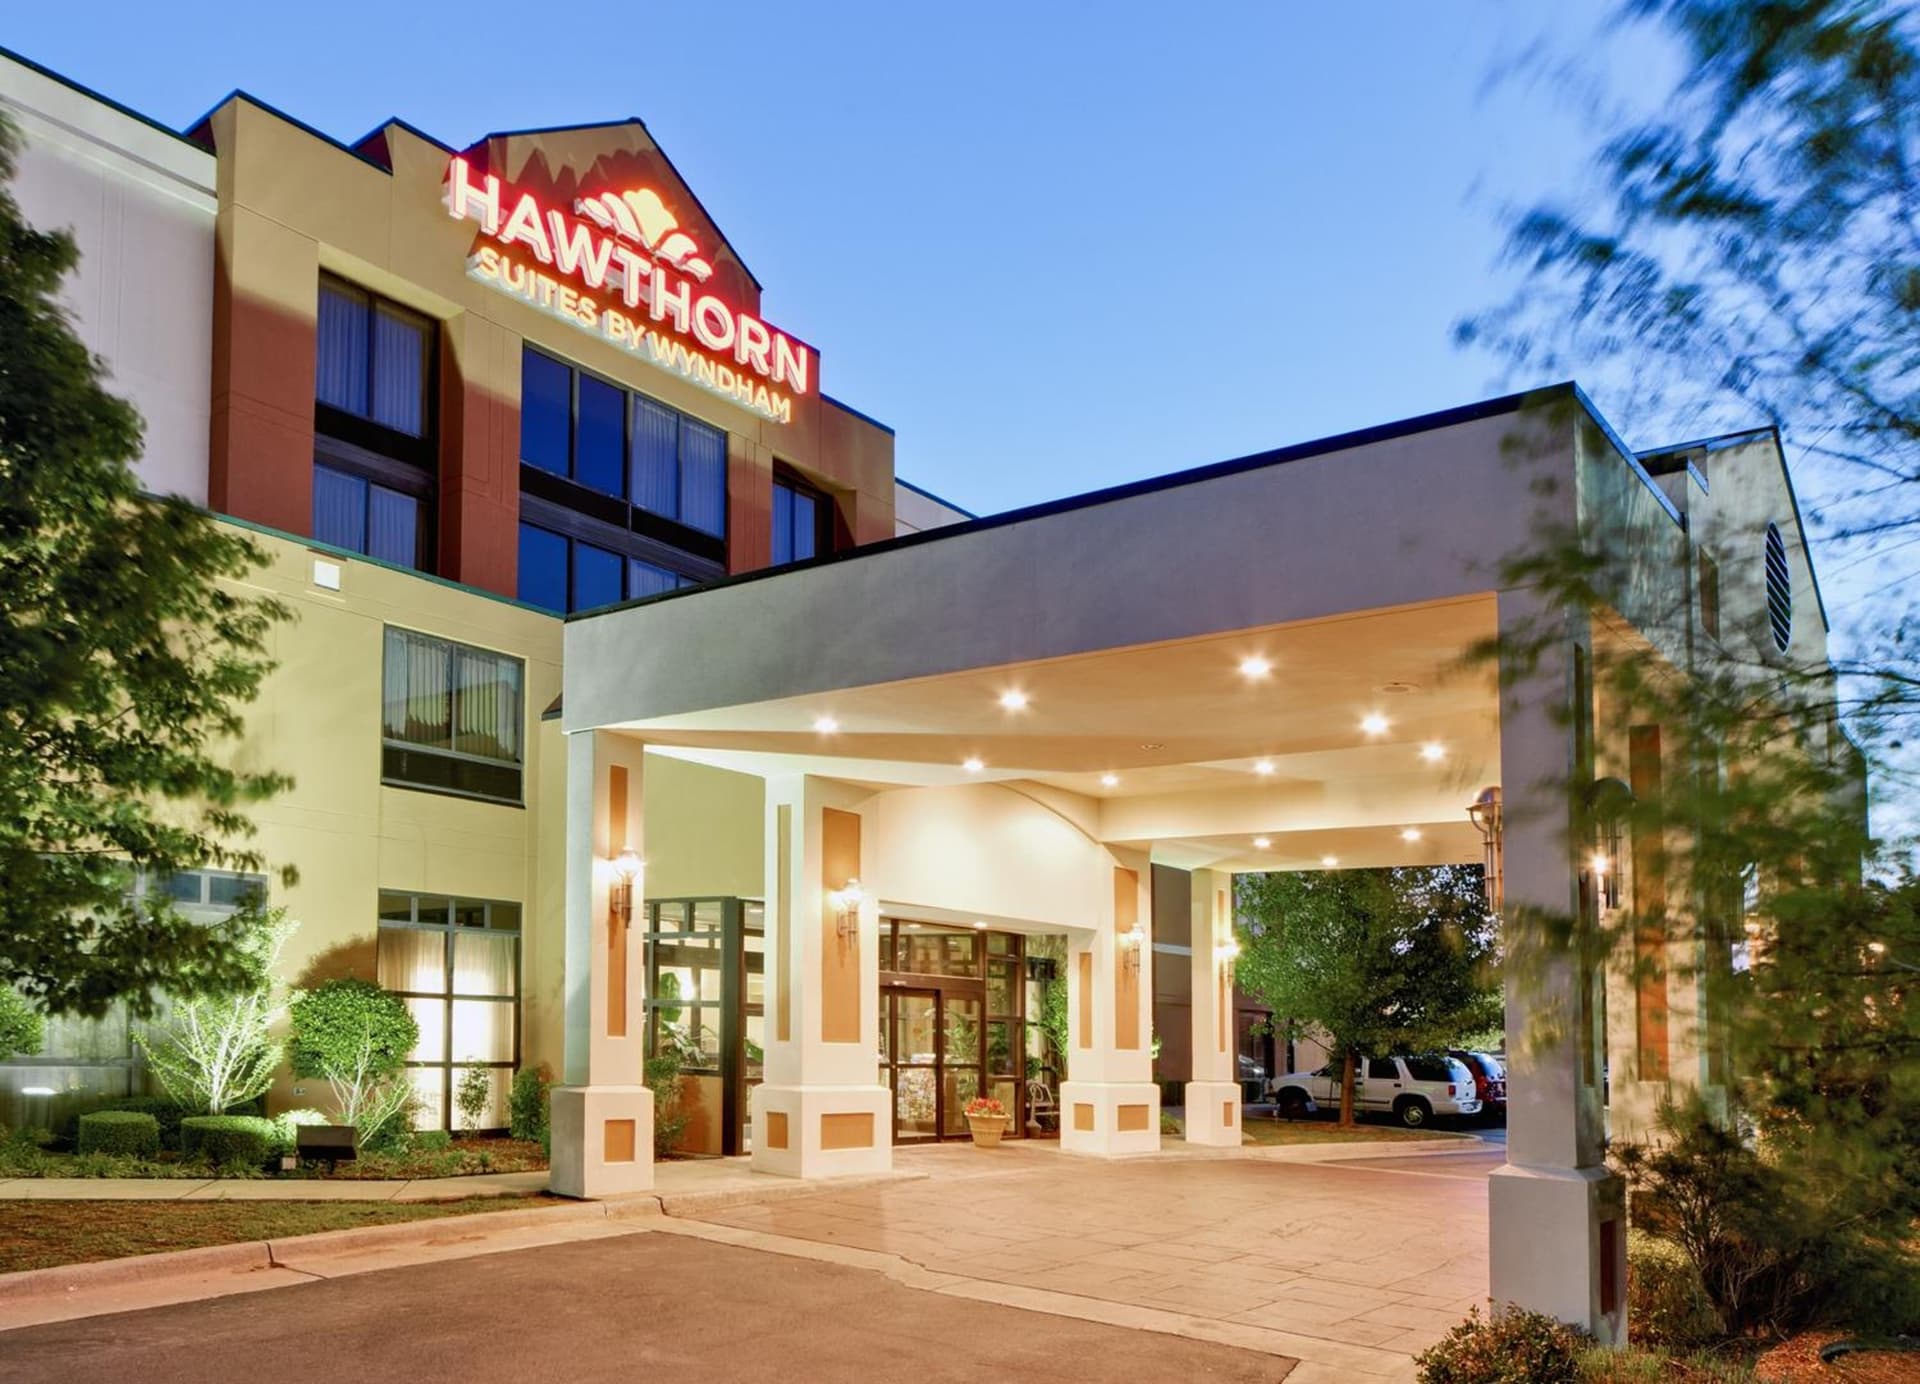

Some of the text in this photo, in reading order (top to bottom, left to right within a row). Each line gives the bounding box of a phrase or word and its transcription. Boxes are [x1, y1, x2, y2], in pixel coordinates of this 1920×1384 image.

[448, 156, 808, 394] HAWTHORN
[477, 246, 792, 425] SUITES BY WYNDHAM
